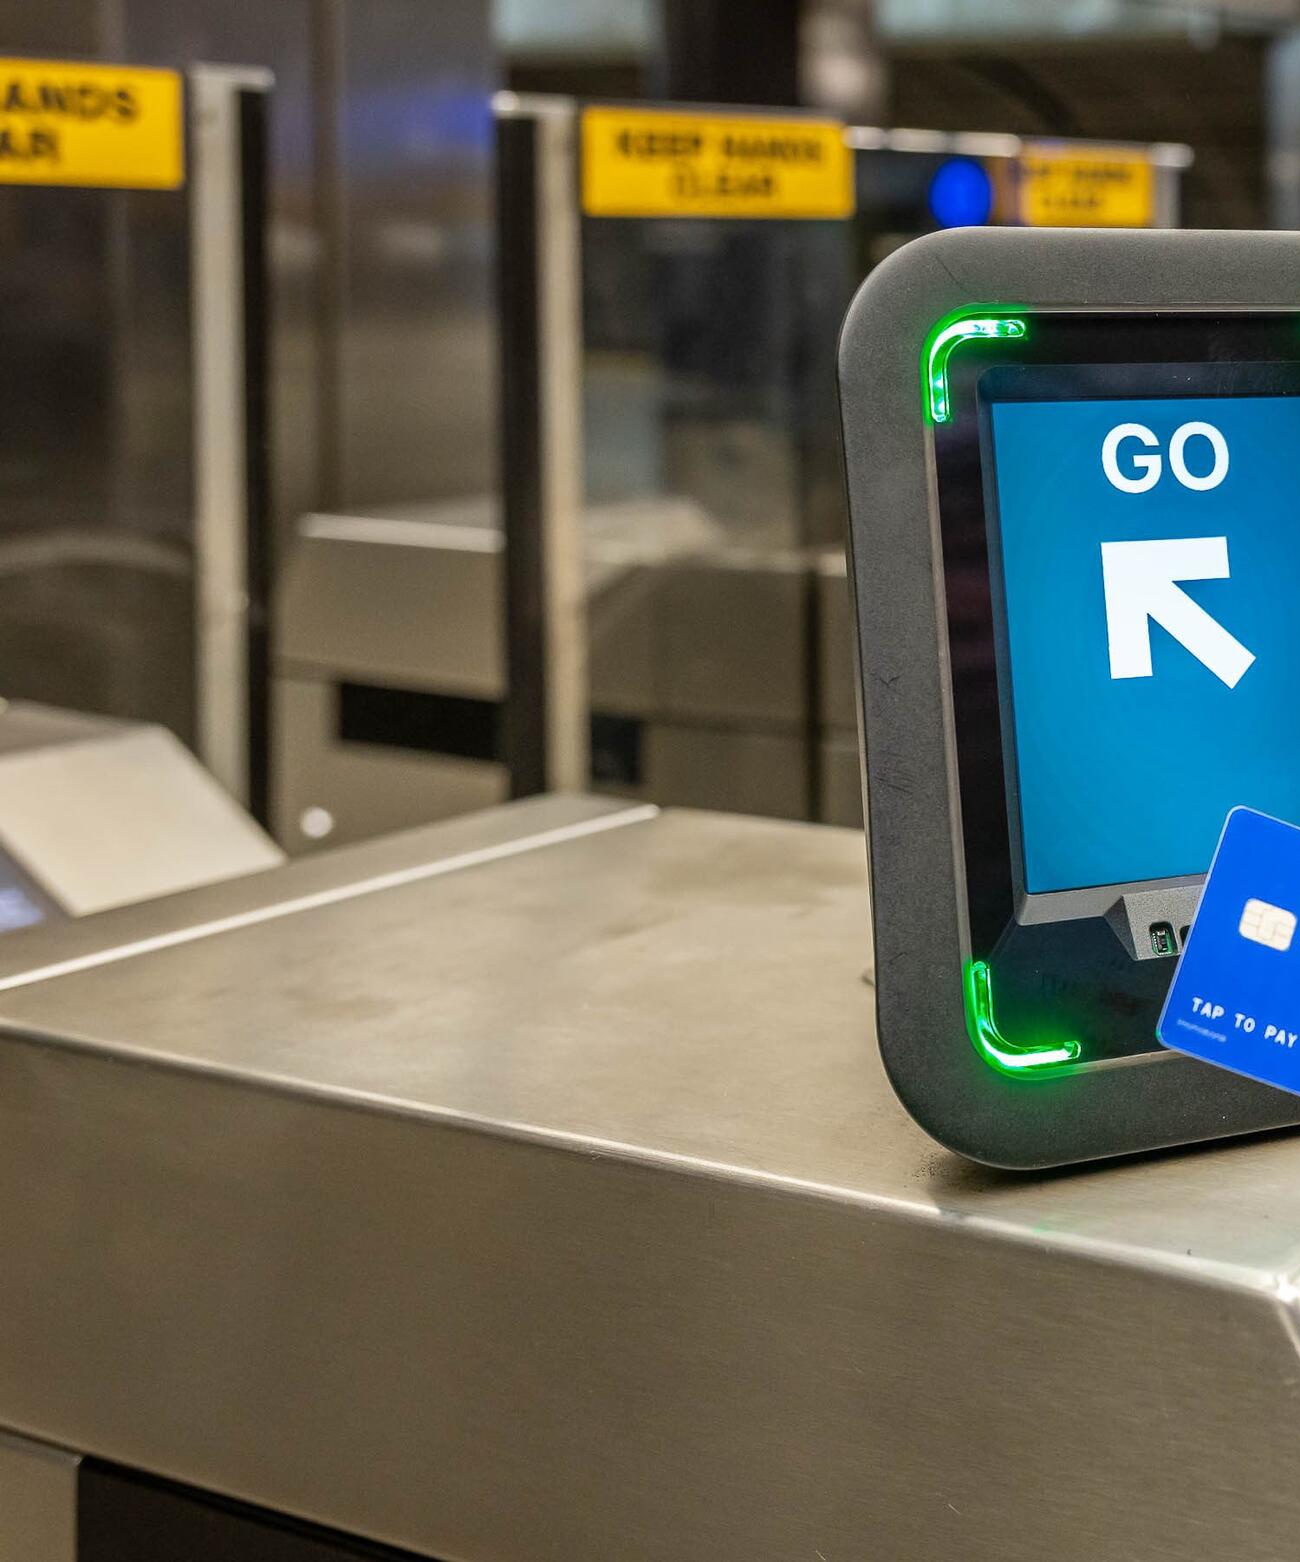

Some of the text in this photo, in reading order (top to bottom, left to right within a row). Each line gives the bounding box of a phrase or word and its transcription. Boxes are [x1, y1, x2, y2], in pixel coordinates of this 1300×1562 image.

[1101, 421, 1230, 494] GO
[1191, 996, 1225, 1020] TAP
[1234, 1012, 1256, 1033] TO
[1264, 1024, 1298, 1048] PAY
